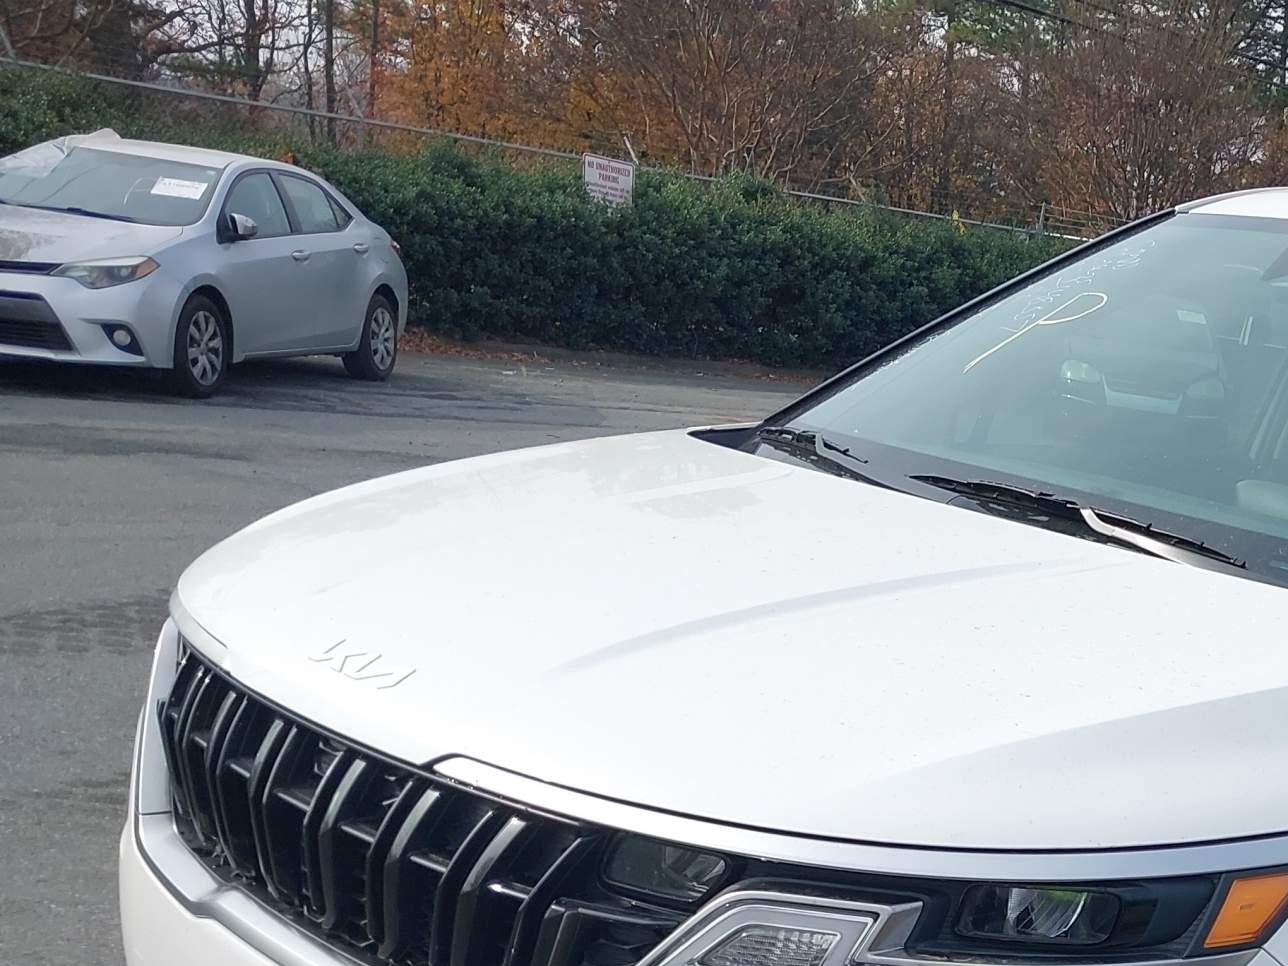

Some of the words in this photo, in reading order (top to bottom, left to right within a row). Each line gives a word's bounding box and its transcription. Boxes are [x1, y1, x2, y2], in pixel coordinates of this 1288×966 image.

[587, 159, 595, 168] NO
[595, 161, 631, 177] UNAUTHORIZED
[598, 172, 620, 184] PARKING
[962, 291, 1109, 375] P
